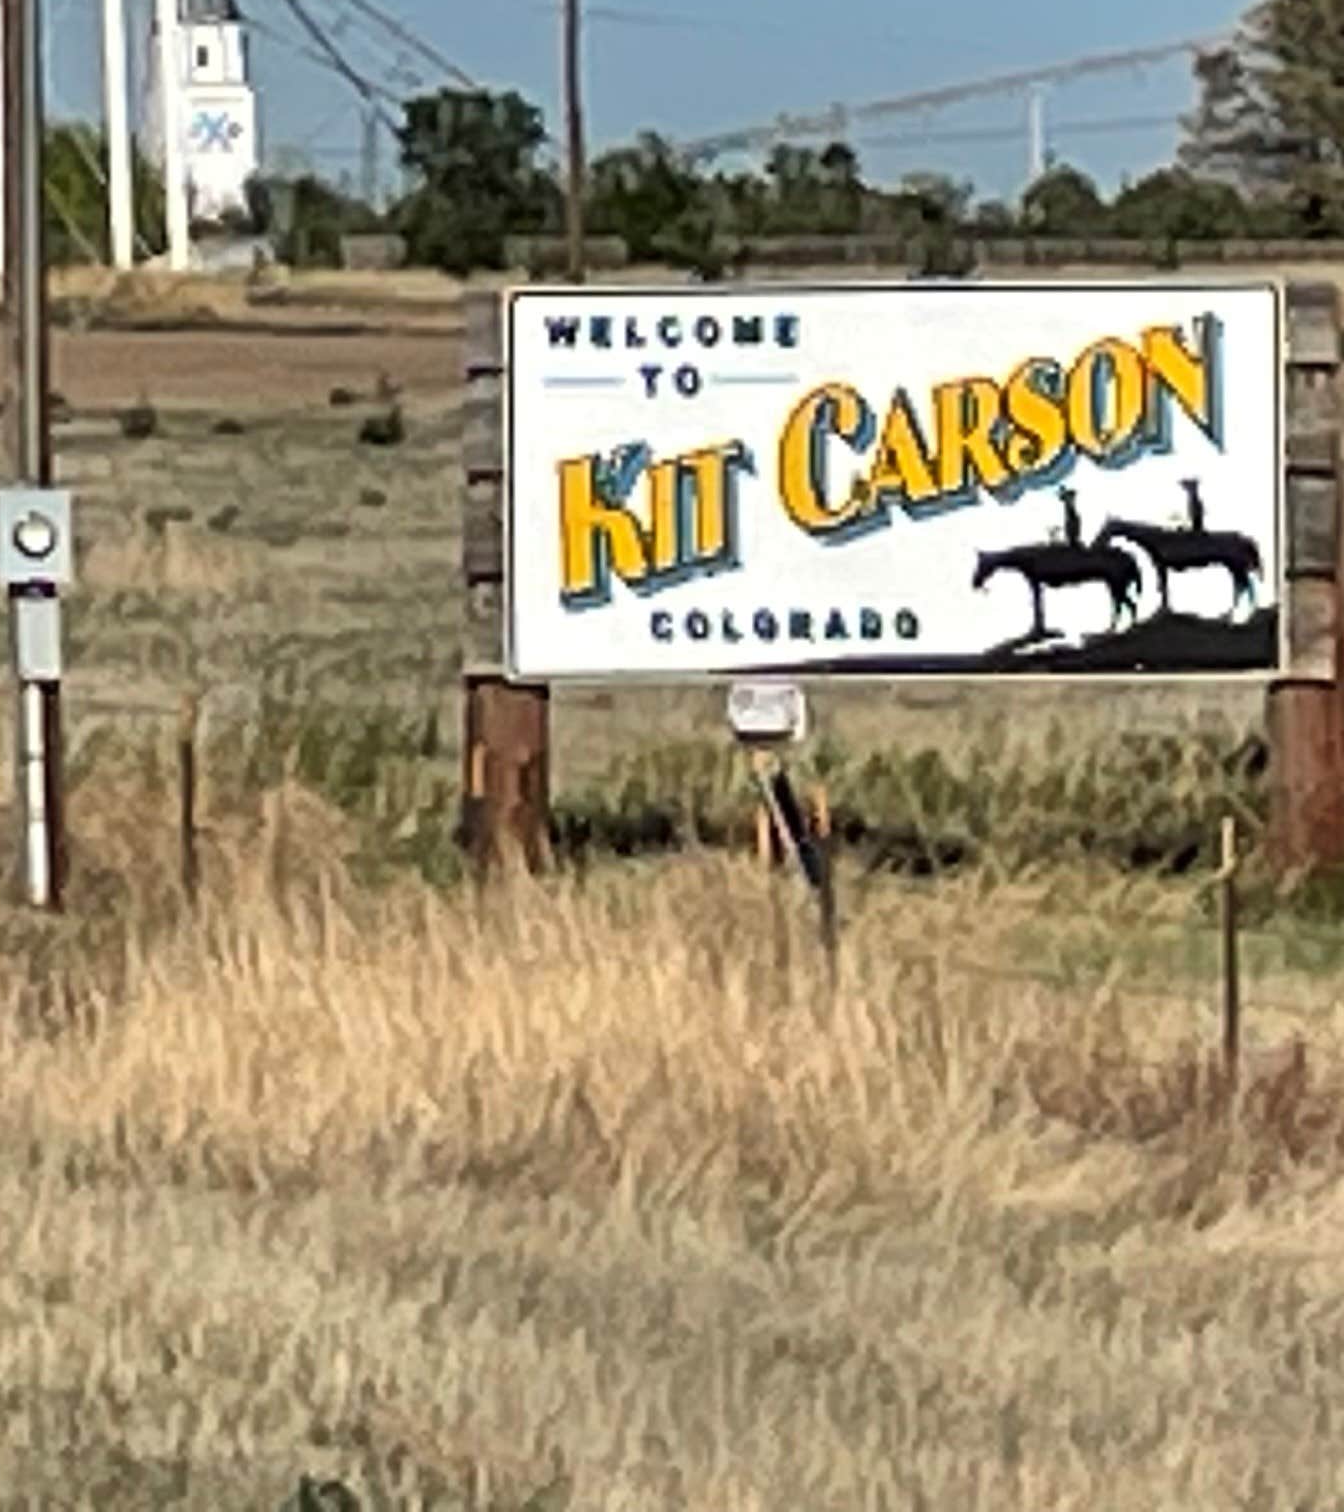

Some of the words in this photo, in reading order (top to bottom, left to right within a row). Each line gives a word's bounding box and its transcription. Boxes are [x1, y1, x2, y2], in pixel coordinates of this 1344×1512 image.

[544, 315, 800, 348] WELCOME
[638, 365, 702, 397] TO
[557, 440, 758, 609] KIT
[778, 312, 1224, 545] CARSON
[650, 611, 920, 642] COLORADO
